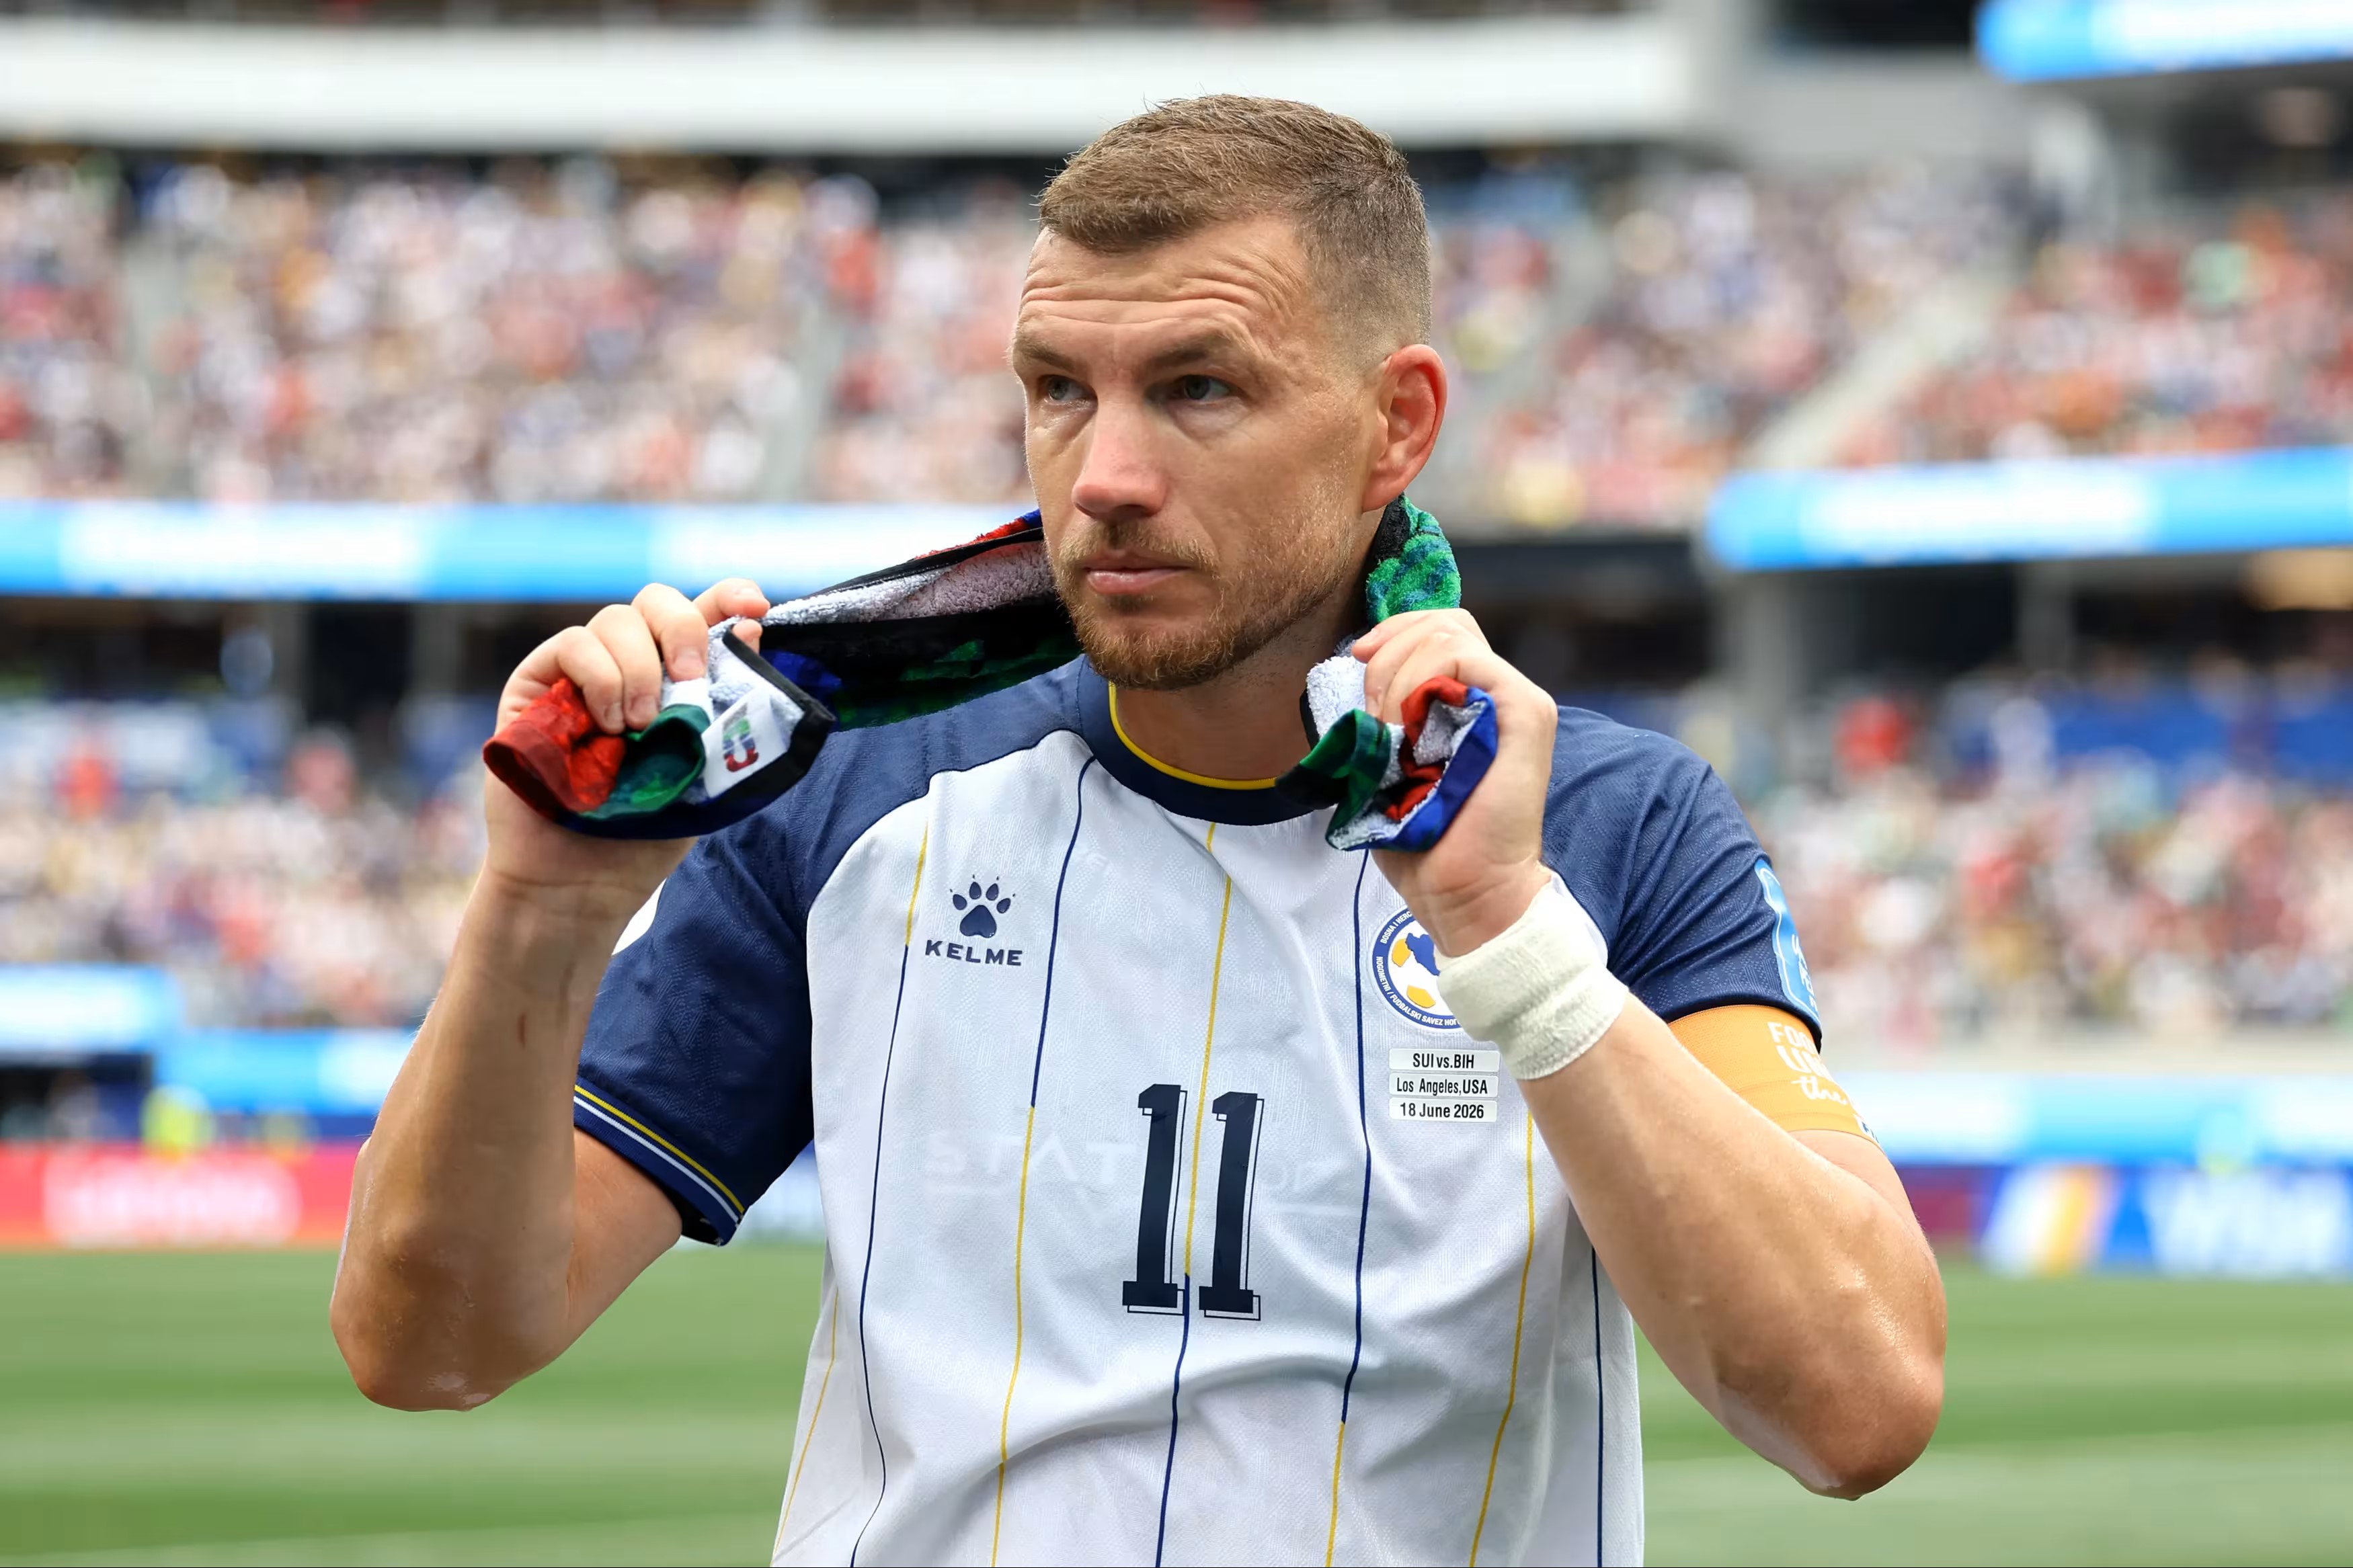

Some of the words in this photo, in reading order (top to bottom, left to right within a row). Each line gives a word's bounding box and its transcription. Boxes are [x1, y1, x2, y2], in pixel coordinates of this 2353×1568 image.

[1380, 925, 1395, 944] BOSNA
[1395, 911, 1412, 925] HERC
[925, 940, 1023, 966] KELME
[1376, 956, 1392, 991] NOGOMETNI
[1390, 994, 1422, 1020] FUDBALSKI
[1421, 1016, 1444, 1026] SAVEZ
[1412, 1053, 1434, 1067] SUI
[1396, 1077, 1414, 1092] Los
[1400, 1102, 1416, 1116] 18
[1419, 1103, 1451, 1118] June
[1453, 1104, 1484, 1119] 2026
[1123, 1083, 1265, 1321] 11
